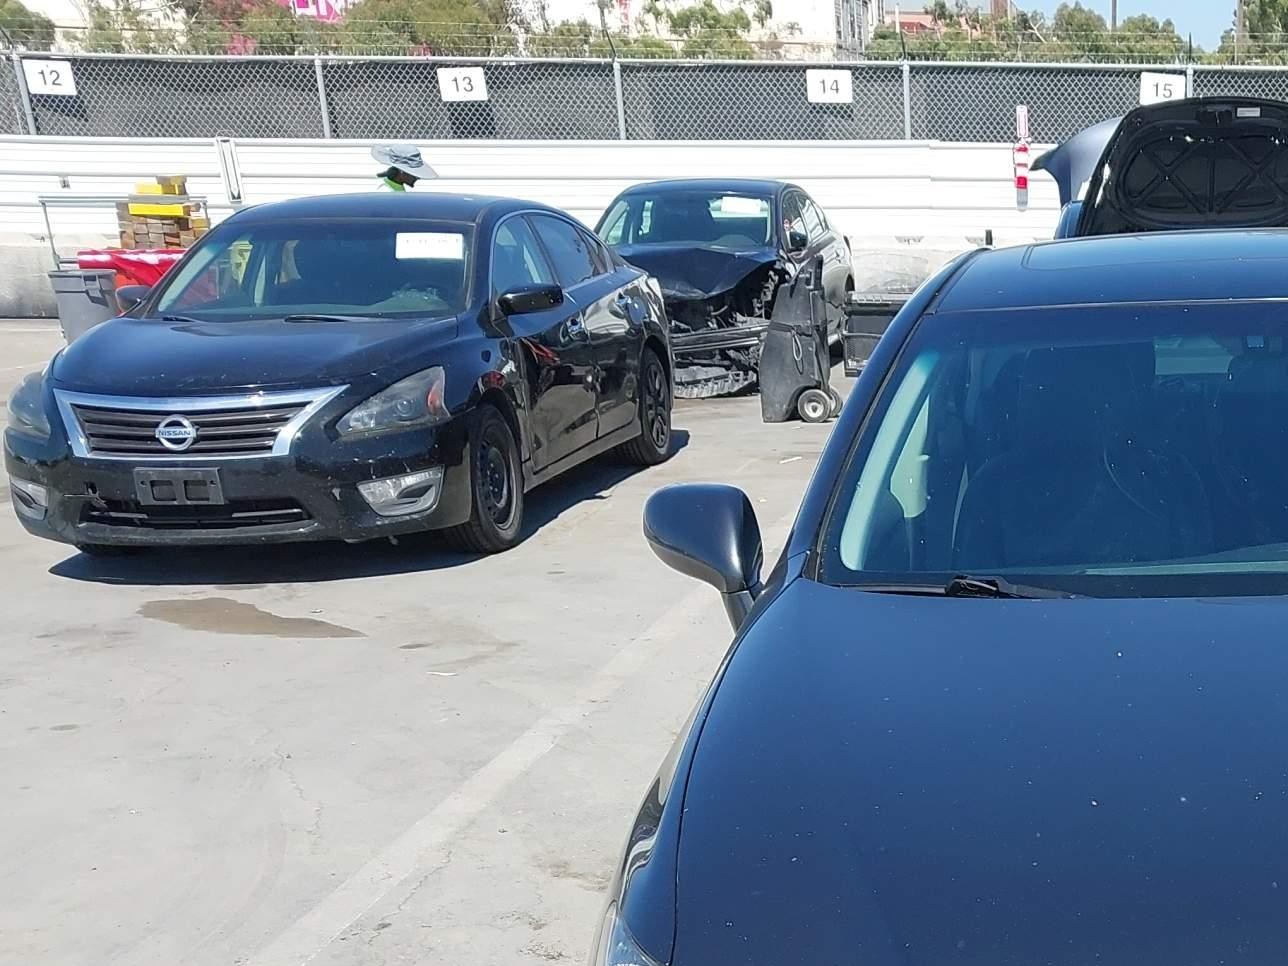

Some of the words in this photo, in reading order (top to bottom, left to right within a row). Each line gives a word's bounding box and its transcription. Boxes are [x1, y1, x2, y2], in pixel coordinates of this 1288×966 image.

[38, 69, 62, 86] 12
[451, 76, 474, 92] 13
[819, 78, 840, 94] 14
[1152, 82, 1173, 99] 15
